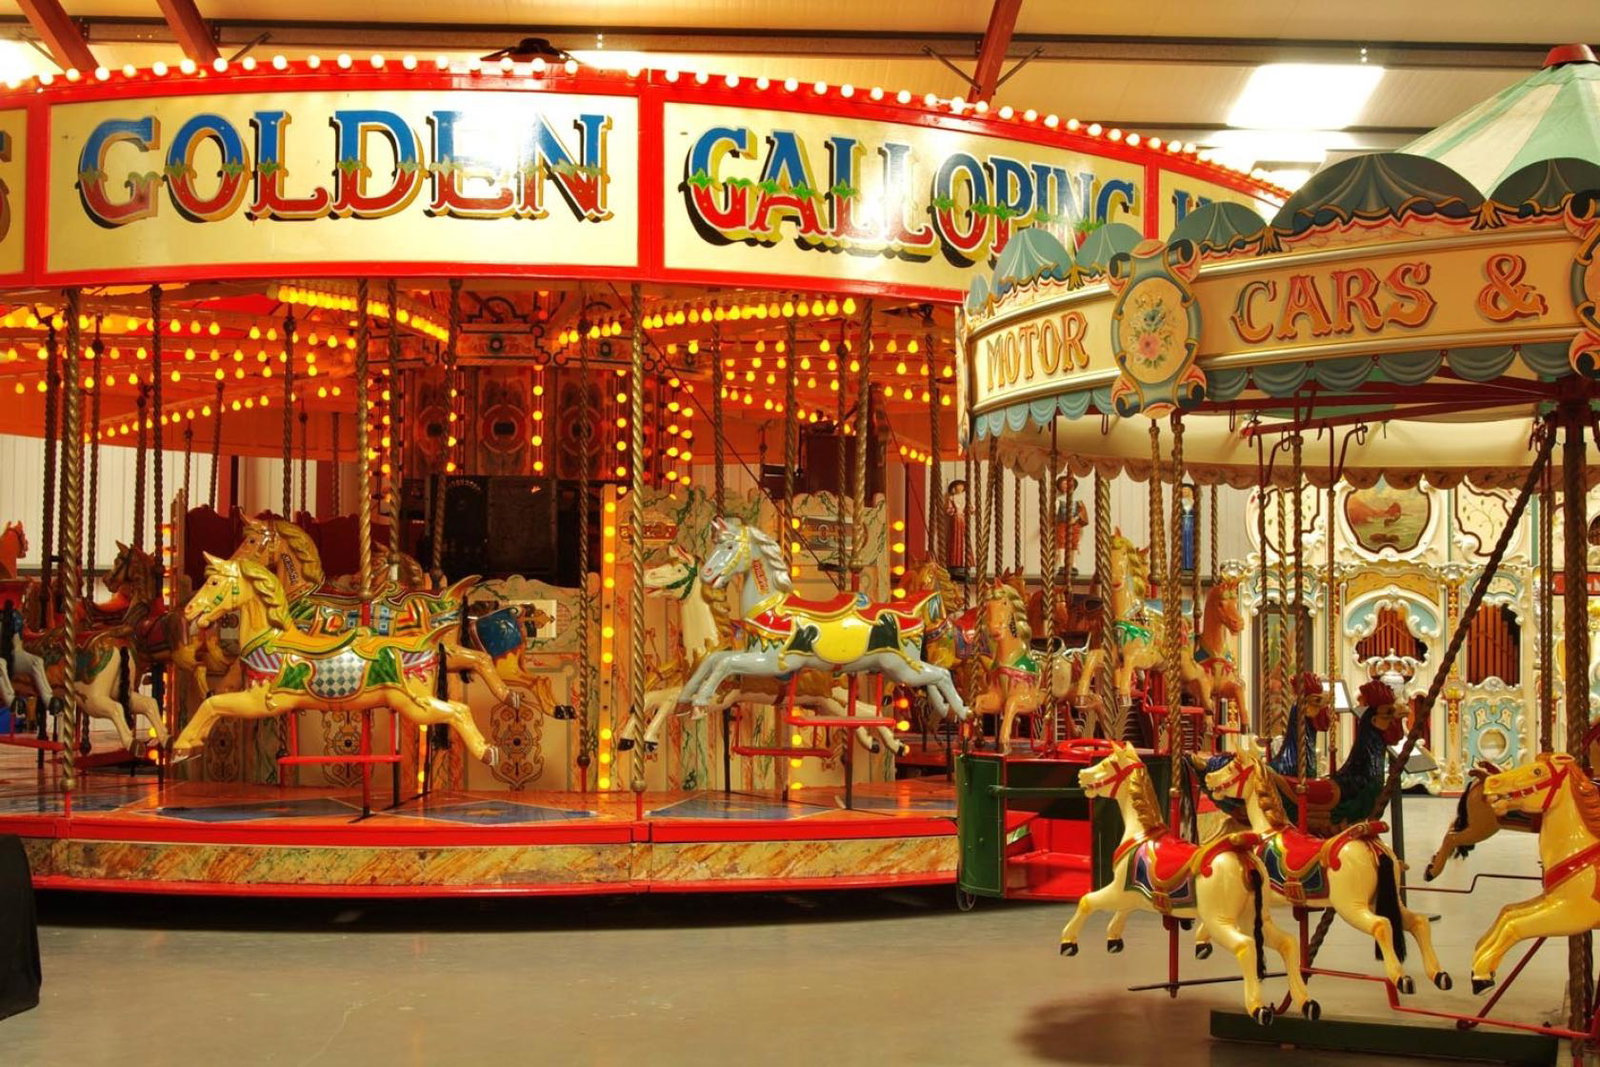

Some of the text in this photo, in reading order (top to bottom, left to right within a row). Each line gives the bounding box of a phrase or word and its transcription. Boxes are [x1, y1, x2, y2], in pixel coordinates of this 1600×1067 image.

[77, 110, 612, 227] GOLDEN
[680, 127, 1138, 267] GALLOPING
[986, 253, 1548, 392] MOTOR CARS &
